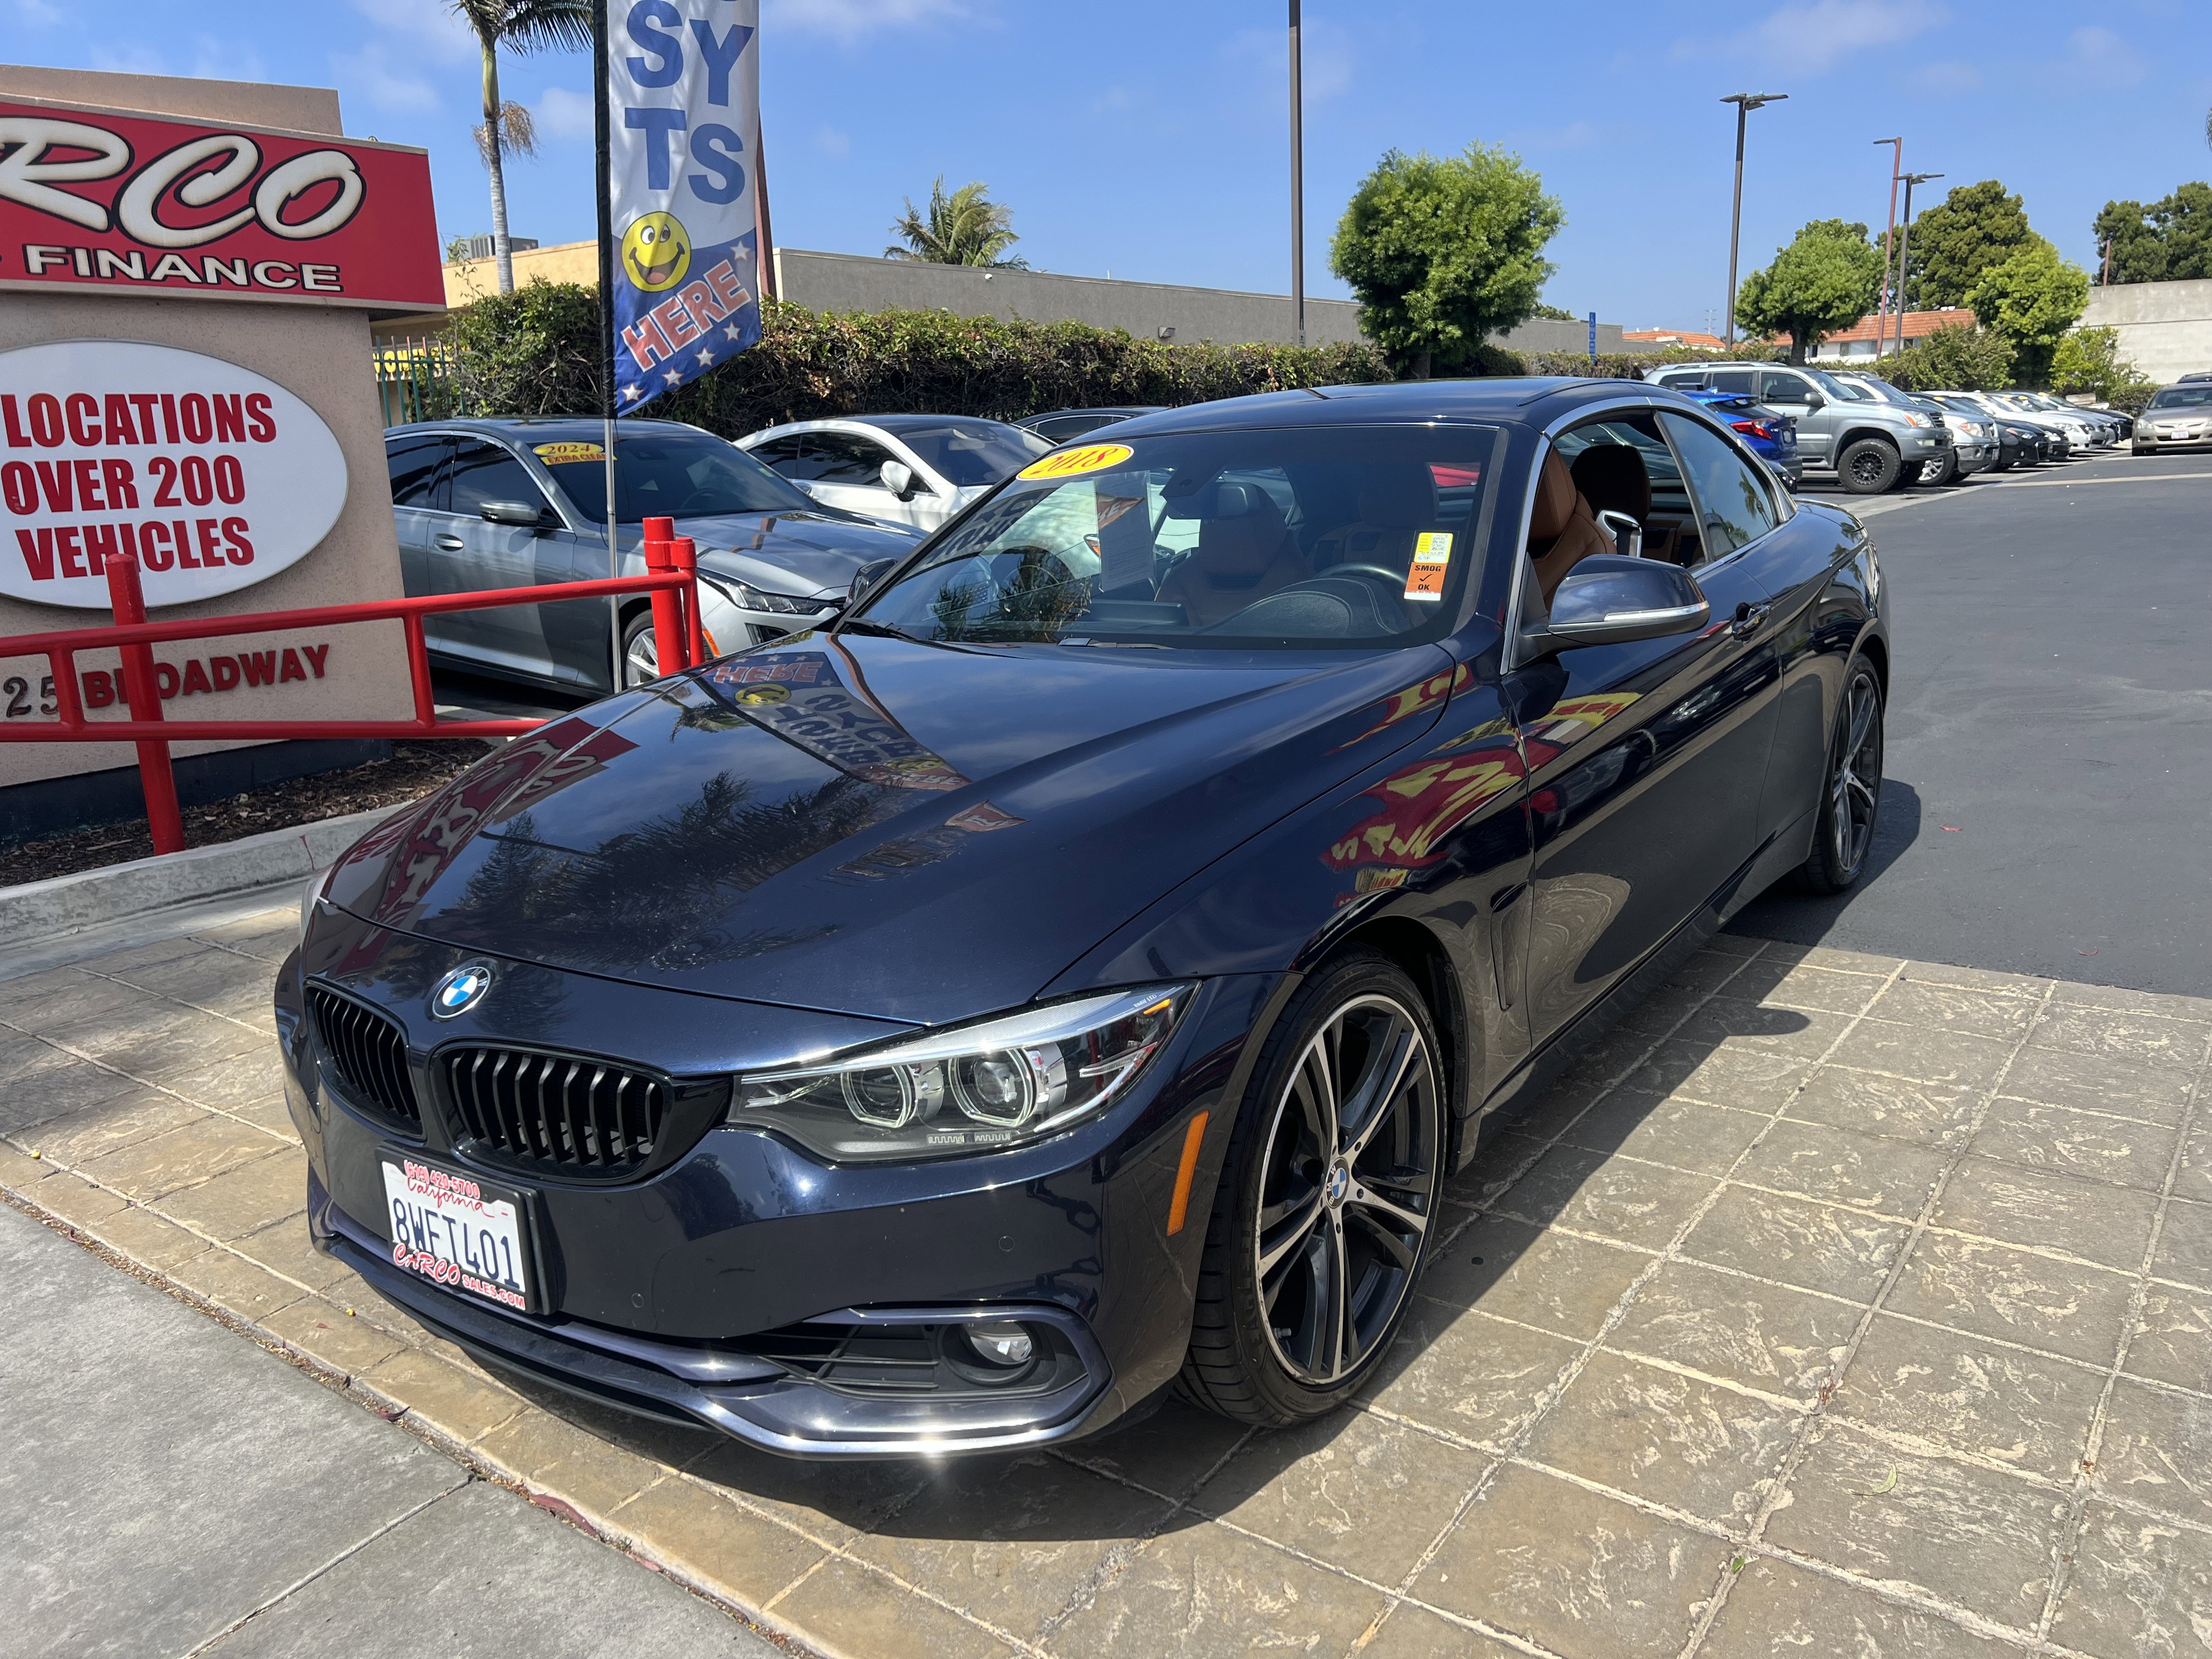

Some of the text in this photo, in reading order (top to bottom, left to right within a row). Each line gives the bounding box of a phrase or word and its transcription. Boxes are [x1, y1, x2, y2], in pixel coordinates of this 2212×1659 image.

[22, 244, 343, 292] FINANCE
[620, 259, 752, 373] HERE
[1, 392, 278, 448] LOCATIONS
[547, 444, 591, 454] 2024
[547, 455, 580, 464] EXTRA
[1028, 448, 1119, 476] 2018
[2, 455, 246, 515] OVER 200
[14, 517, 255, 580] VEHICLES
[3, 676, 59, 718] 25
[404, 1159, 481, 1200] (619) 420-5700
[407, 1177, 495, 1218] California
[1327, 1165, 1336, 1205] BMW
[393, 1198, 521, 1290] 8WFT401
